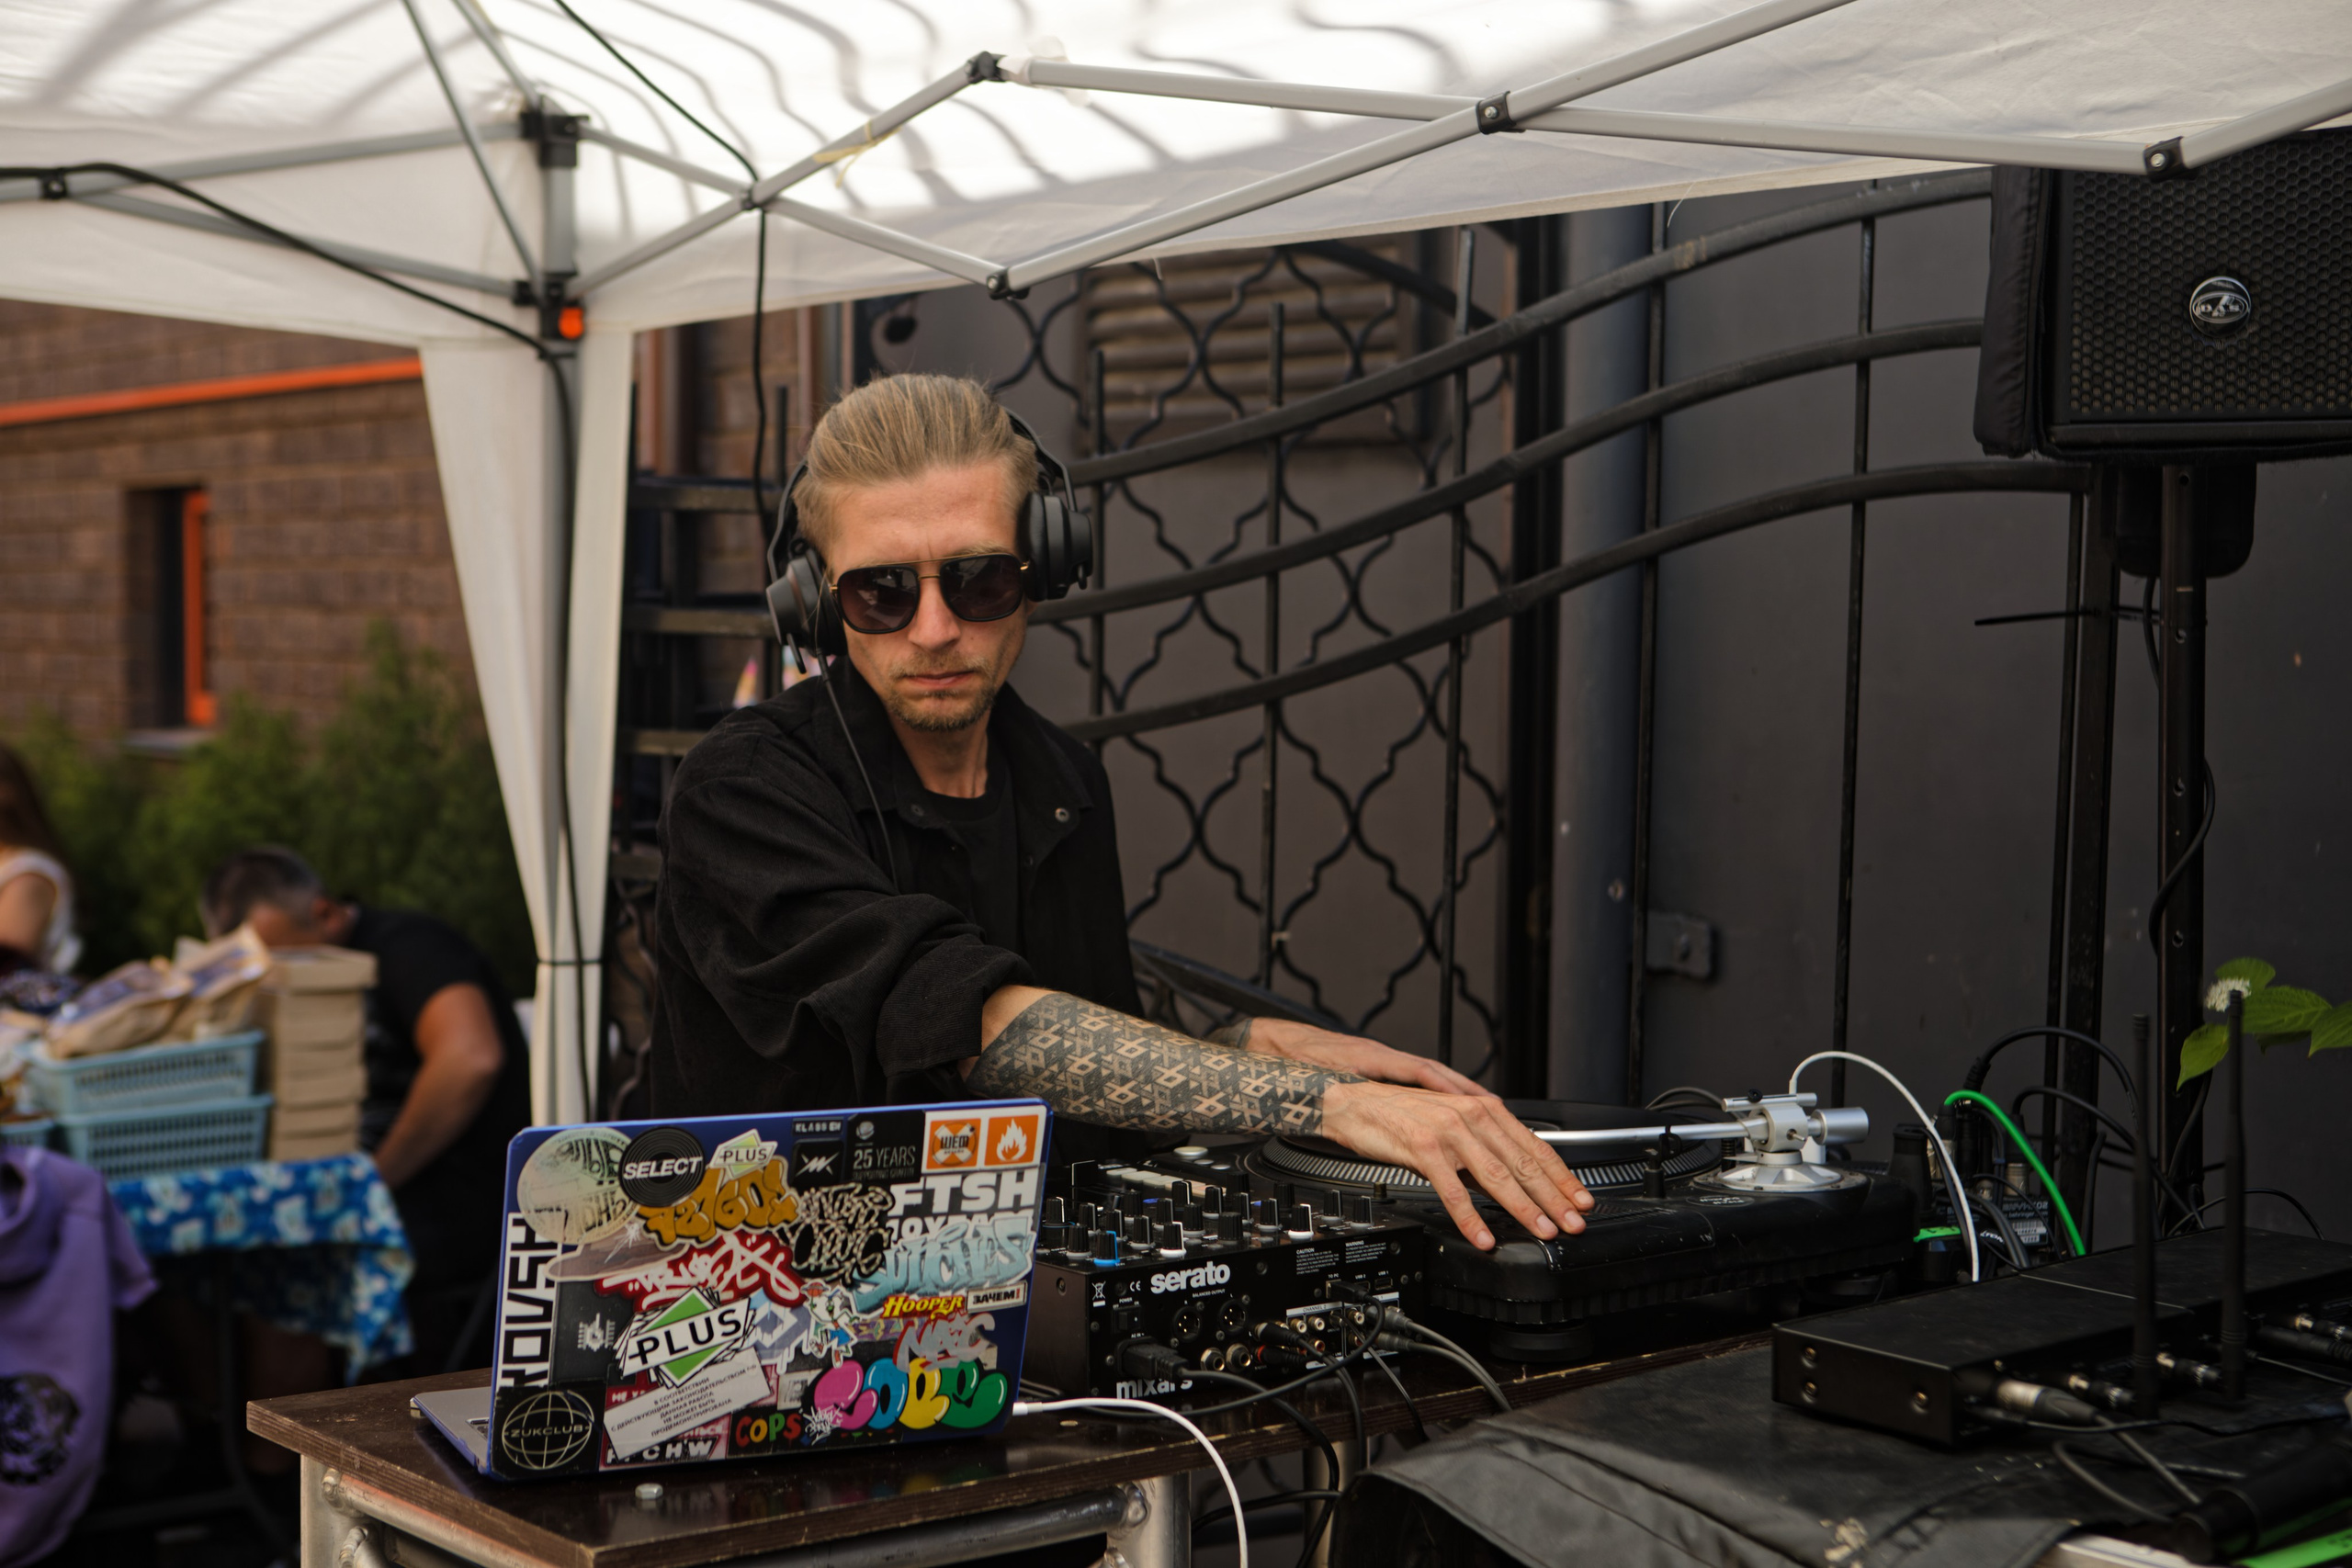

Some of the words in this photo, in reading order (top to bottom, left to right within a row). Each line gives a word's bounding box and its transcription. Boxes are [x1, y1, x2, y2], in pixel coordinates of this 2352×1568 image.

[623, 1156, 704, 1179] SELECT
[719, 1147, 769, 1162] PLUS
[854, 1149, 873, 1169] 25
[876, 1145, 916, 1168] YEARS
[888, 1168, 1040, 1217] FTSH
[1150, 1261, 1230, 1294] serato
[881, 1295, 965, 1321] HOOPER
[972, 1289, 1021, 1304] ЗАЧЕМ!
[628, 1308, 742, 1366] PLUS
[616, 1403, 670, 1431] ДЕЙСТВУЮЩИМ
[672, 1369, 746, 1405] ЗАКОНОДАТЕЛЬСТВОМ
[660, 1402, 687, 1419] ДАННАЯ
[688, 1391, 714, 1406] РАБОТА
[673, 1404, 696, 1421] МОЖЕТ
[698, 1398, 716, 1408] БЫТЬ
[511, 1424, 583, 1438] ZUKCLUB
[650, 1398, 732, 1437] ПРОДЕМОНСТРИРОВАНА
[736, 1413, 802, 1448] COPS
